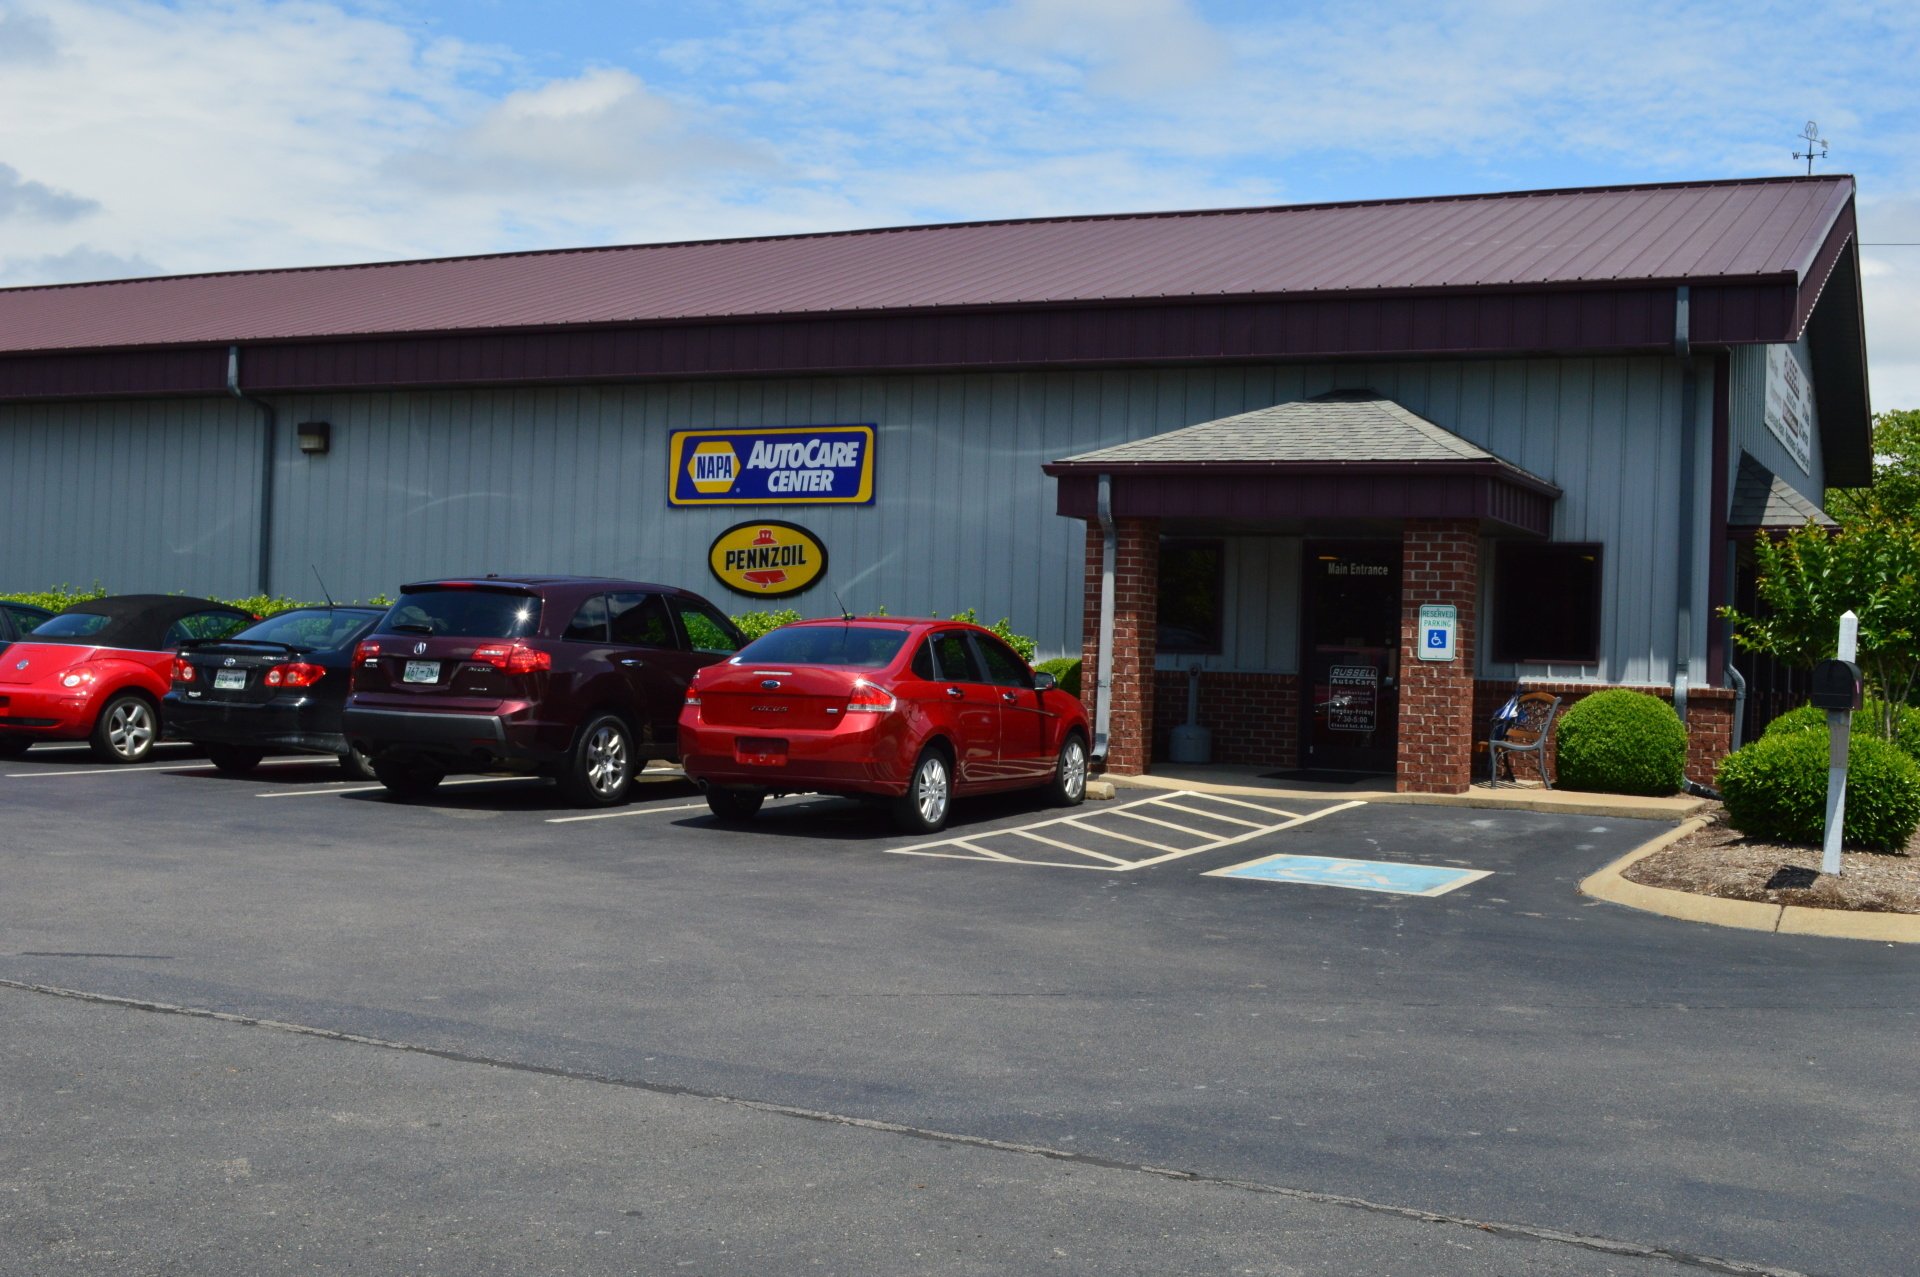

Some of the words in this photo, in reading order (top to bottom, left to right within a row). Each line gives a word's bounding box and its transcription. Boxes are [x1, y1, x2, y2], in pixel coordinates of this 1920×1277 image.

[696, 455, 732, 479] NAPA
[768, 470, 834, 492] CENTER
[725, 545, 806, 571] PENNZOIL
[1328, 563, 1348, 575] Main
[1350, 563, 1389, 576] Entrance
[1422, 610, 1453, 618] RESERVED
[1424, 619, 1451, 627] PARKING
[1332, 668, 1375, 677] RUSSELL
